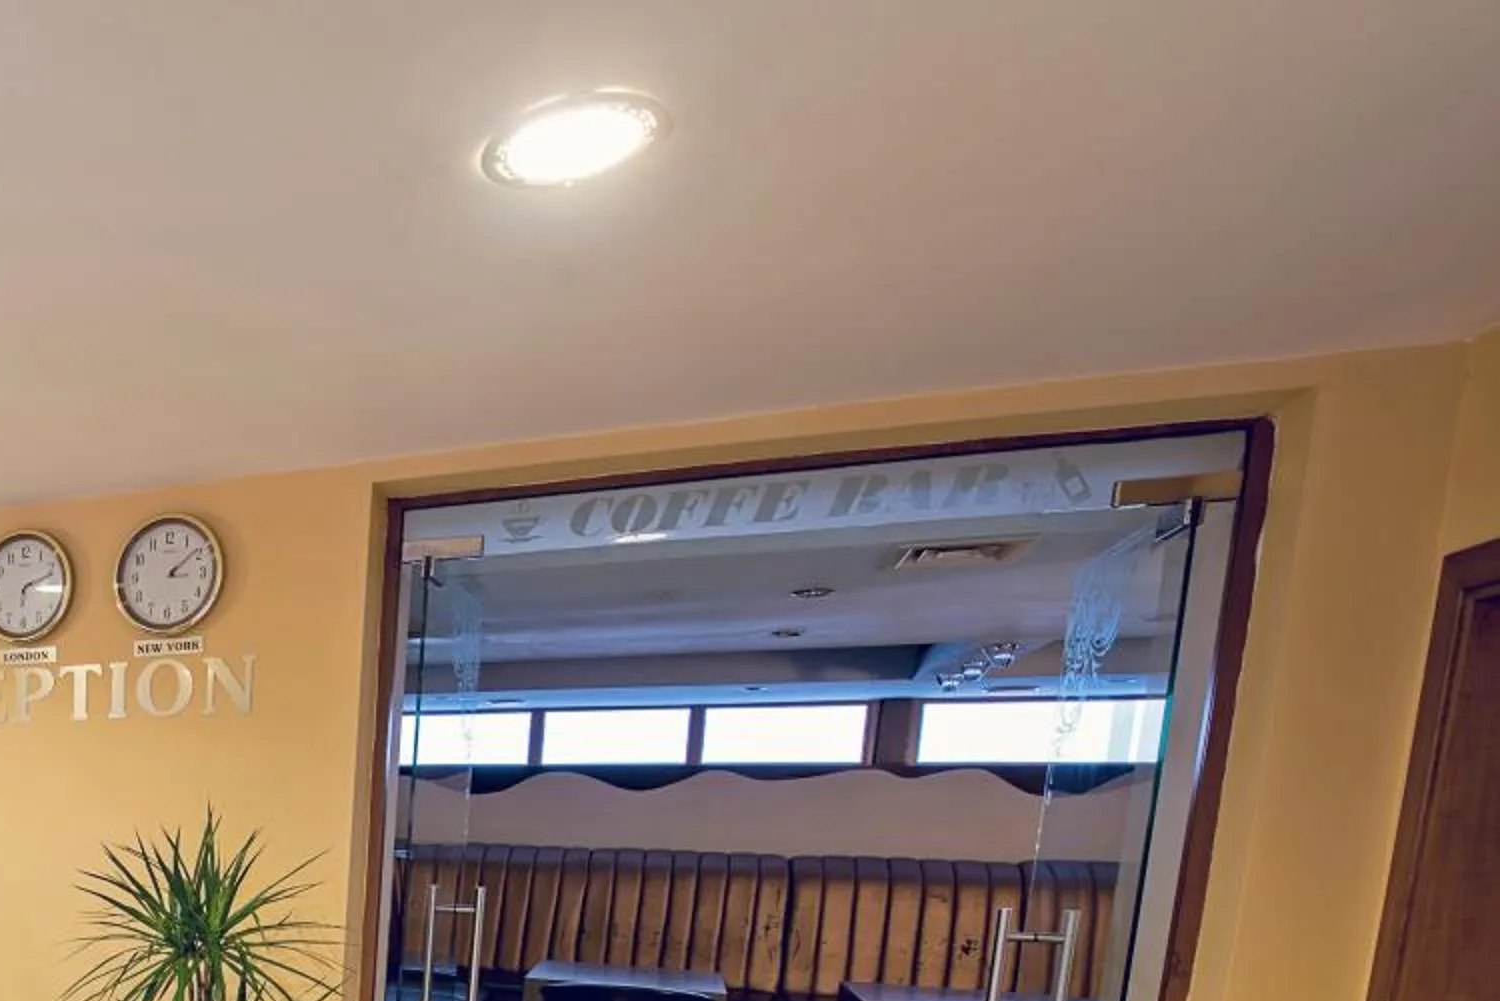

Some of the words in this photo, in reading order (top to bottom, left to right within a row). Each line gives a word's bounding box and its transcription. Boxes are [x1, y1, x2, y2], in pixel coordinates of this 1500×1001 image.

[569, 479, 809, 537] COFFE
[827, 461, 1009, 518] BAR
[137, 643, 162, 655] NEW
[166, 640, 199, 652] YORK
[3, 650, 49, 663] LONDON
